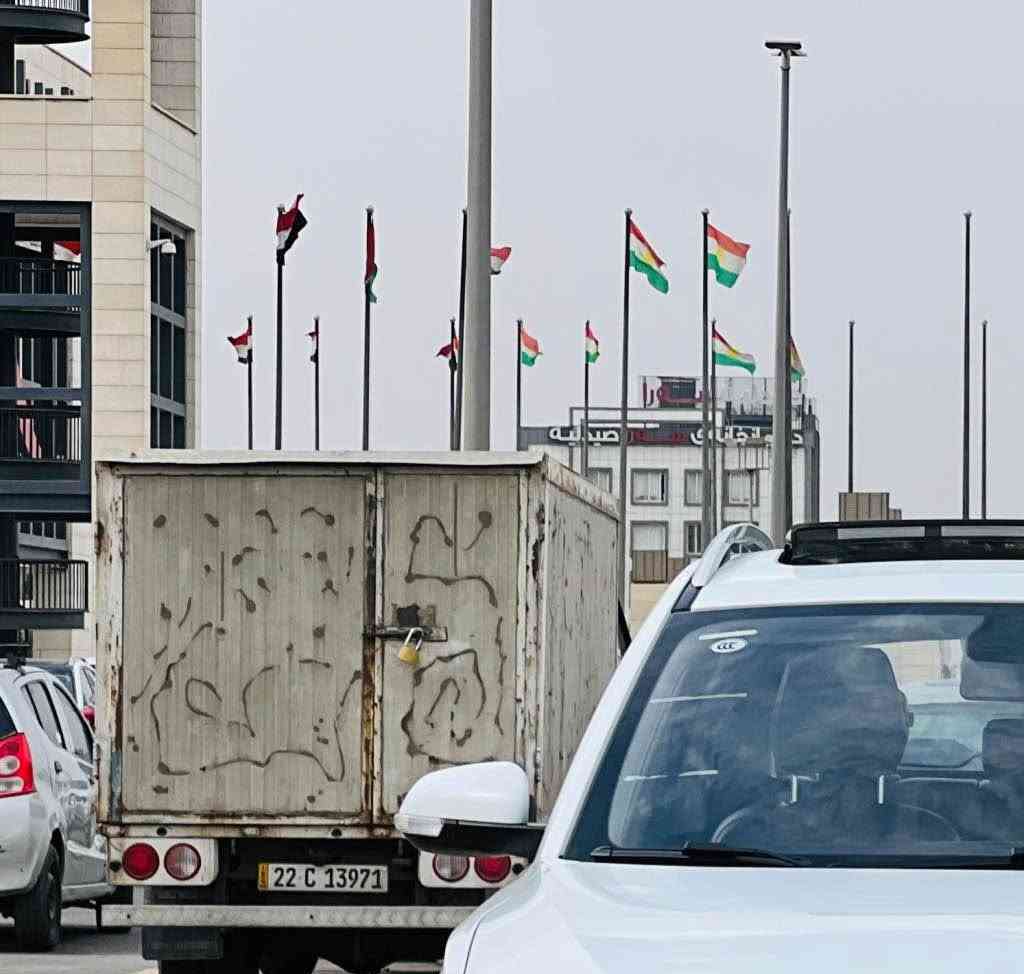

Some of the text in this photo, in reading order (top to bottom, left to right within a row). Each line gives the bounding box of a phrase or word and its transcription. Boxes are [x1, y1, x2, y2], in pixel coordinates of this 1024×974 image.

[273, 867, 296, 888] 22
[304, 867, 316, 888] C
[324, 868, 382, 890] 13971
